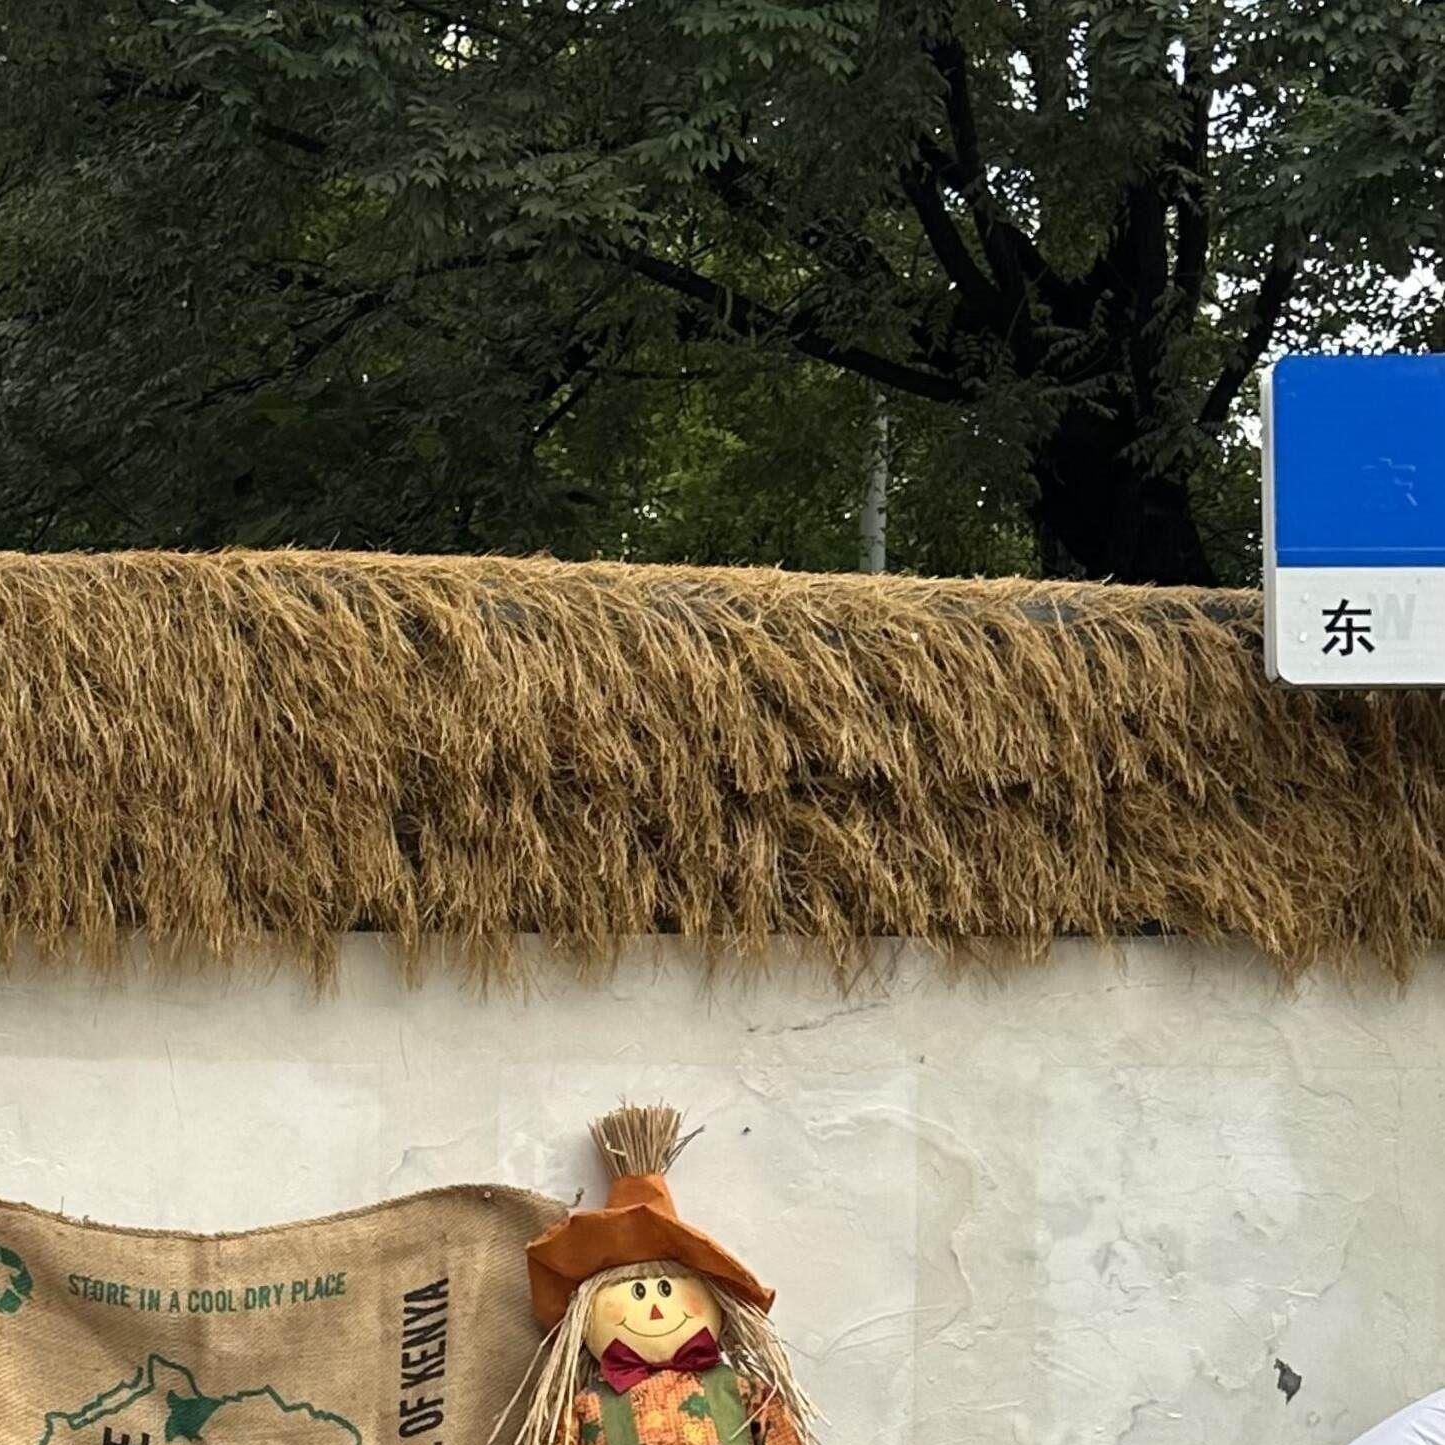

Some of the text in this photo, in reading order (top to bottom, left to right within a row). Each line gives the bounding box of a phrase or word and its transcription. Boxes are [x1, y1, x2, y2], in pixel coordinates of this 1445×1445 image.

[1321, 598, 1375, 656] 东
[67, 1272, 347, 1313] STORE IN A COOL DRY PLACE
[400, 1278, 449, 1390] KENYA
[399, 1395, 445, 1438] OF
